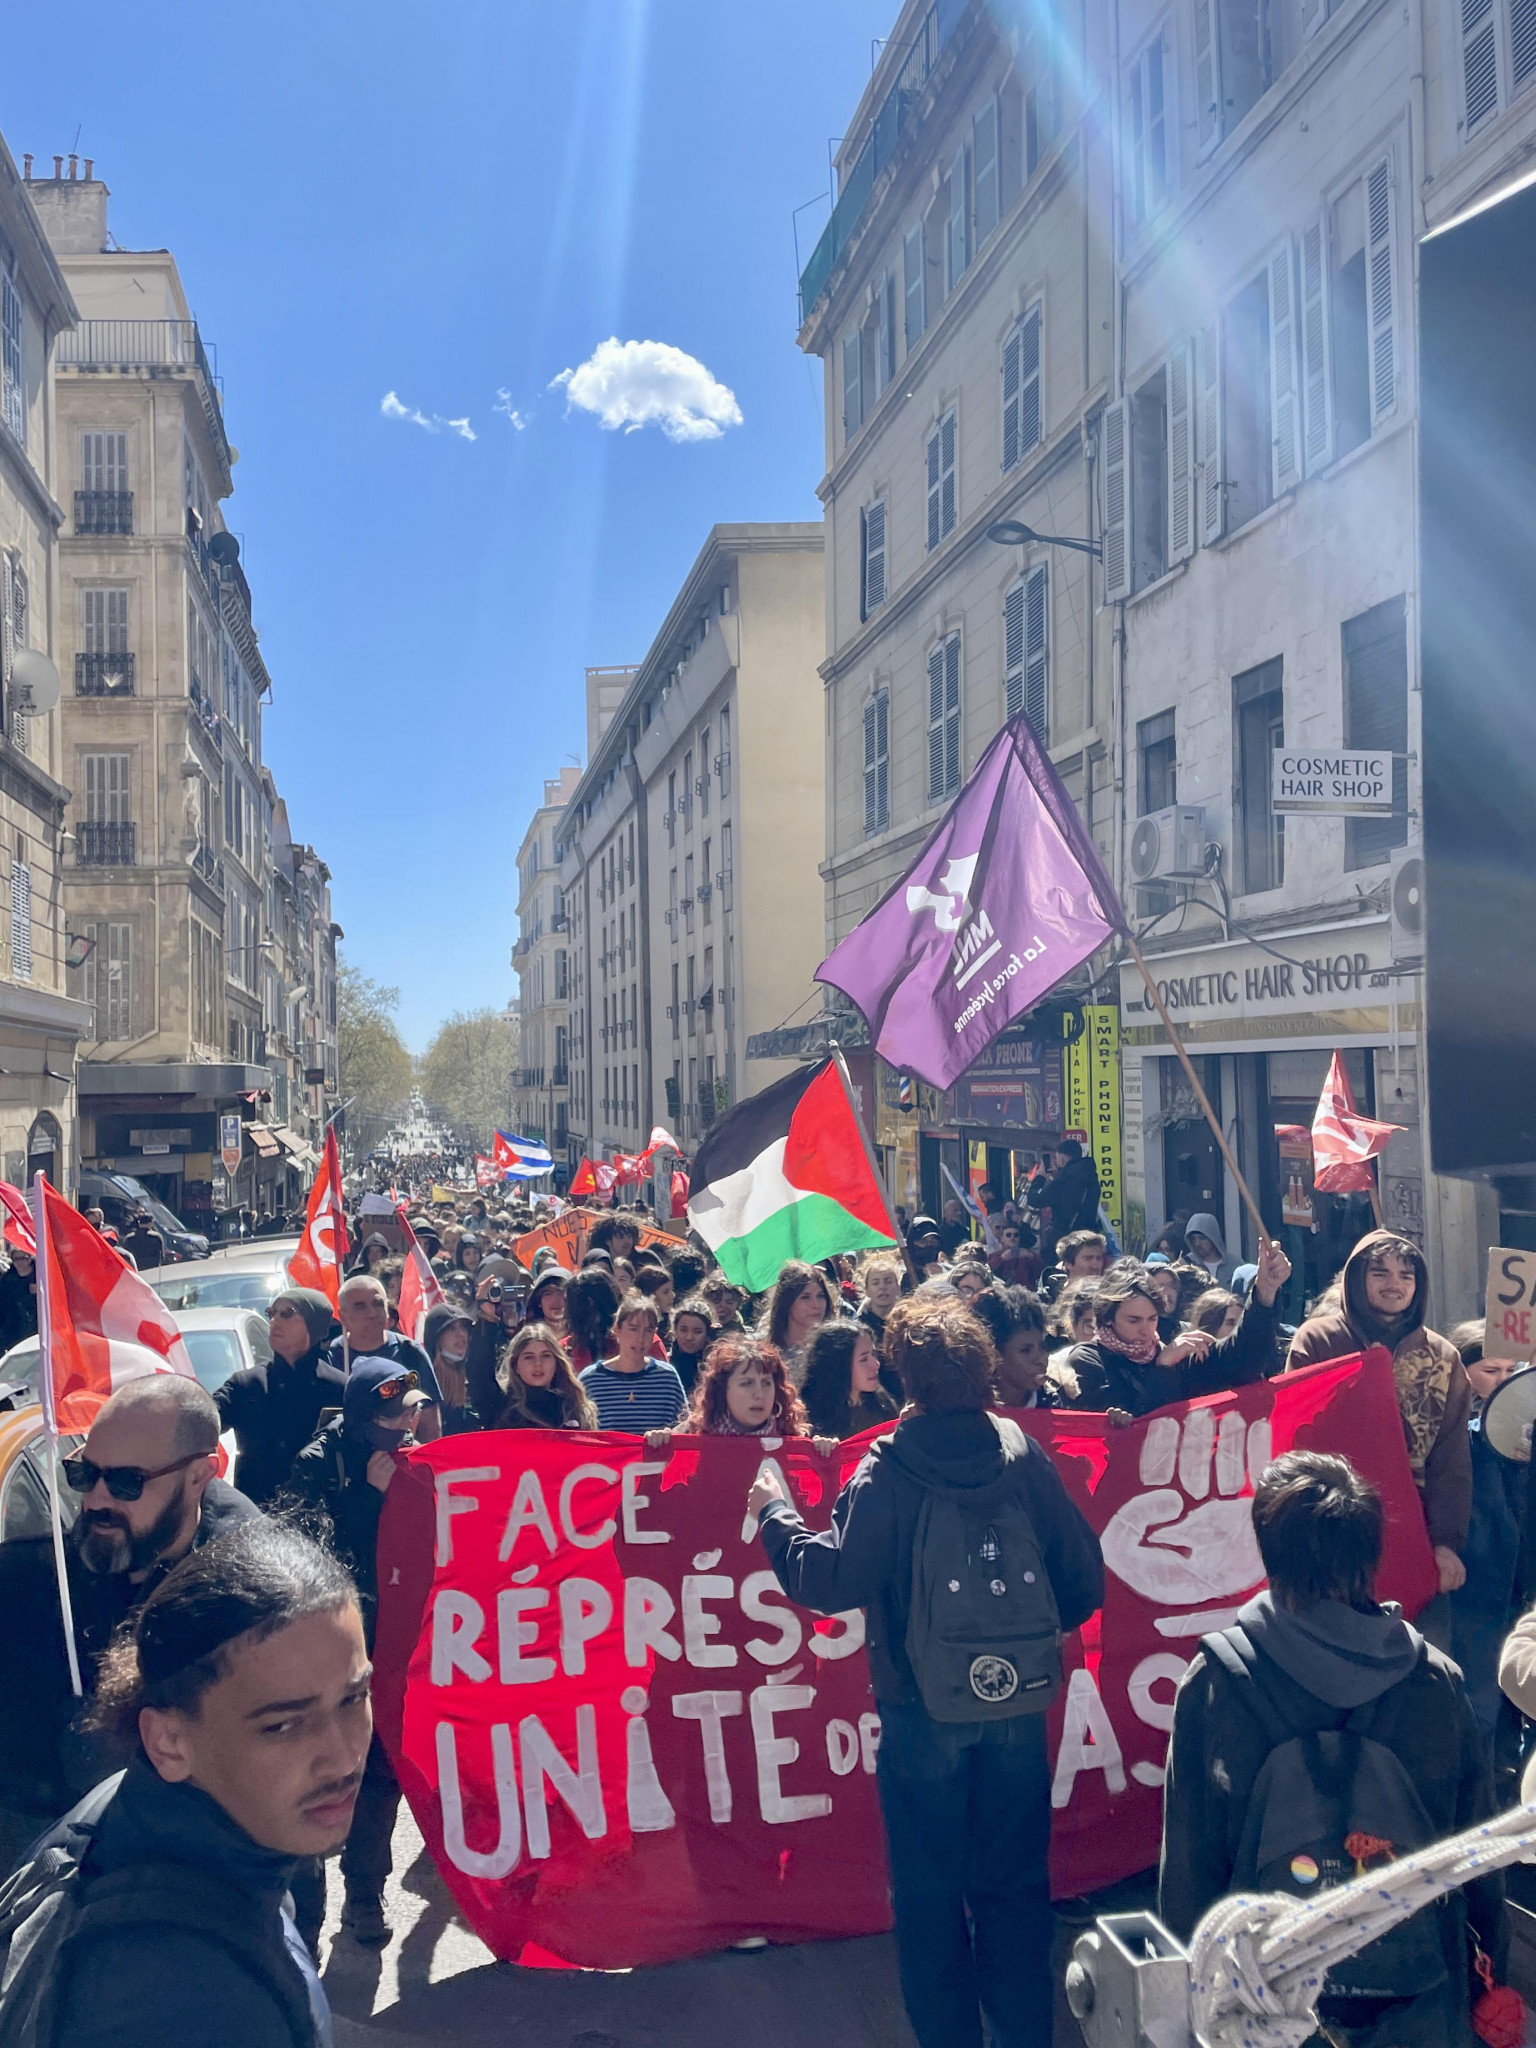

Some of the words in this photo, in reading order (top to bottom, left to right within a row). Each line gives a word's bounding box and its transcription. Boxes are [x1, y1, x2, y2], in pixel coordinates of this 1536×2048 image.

[1282, 757, 1384, 777] COSMETIC
[1281, 779, 1324, 796] HAIR
[1332, 780, 1384, 798] SHOP
[1245, 963, 1295, 1001] HAIR
[996, 1041, 1034, 1065] PHONE
[1096, 1015, 1112, 1068] SMART
[1099, 1081, 1112, 1134] PHONE
[227, 1118, 234, 1129] P
[435, 1461, 674, 1567] FACE
